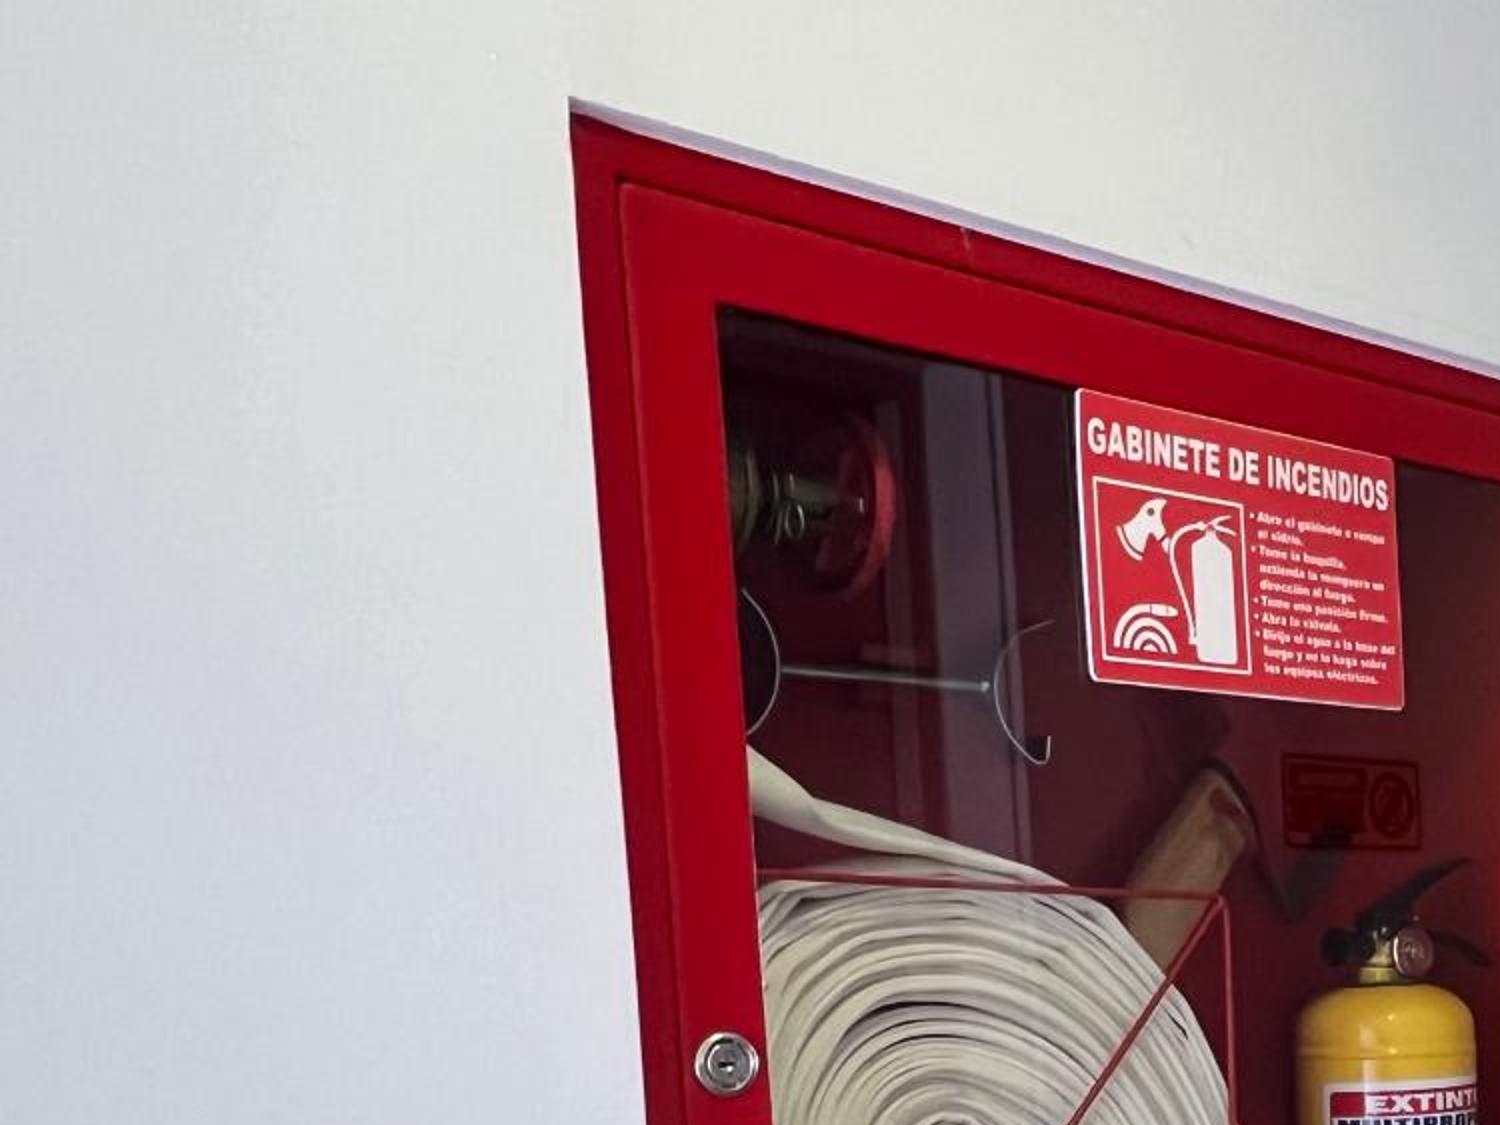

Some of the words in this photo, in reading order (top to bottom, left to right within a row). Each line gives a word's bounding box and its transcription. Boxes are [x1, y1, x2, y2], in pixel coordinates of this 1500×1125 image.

[1087, 417, 1221, 479] GABINETE
[1228, 446, 1260, 485] DE
[1267, 455, 1389, 511] INCENDIOS
[1365, 1088, 1477, 1114] EXTINT
